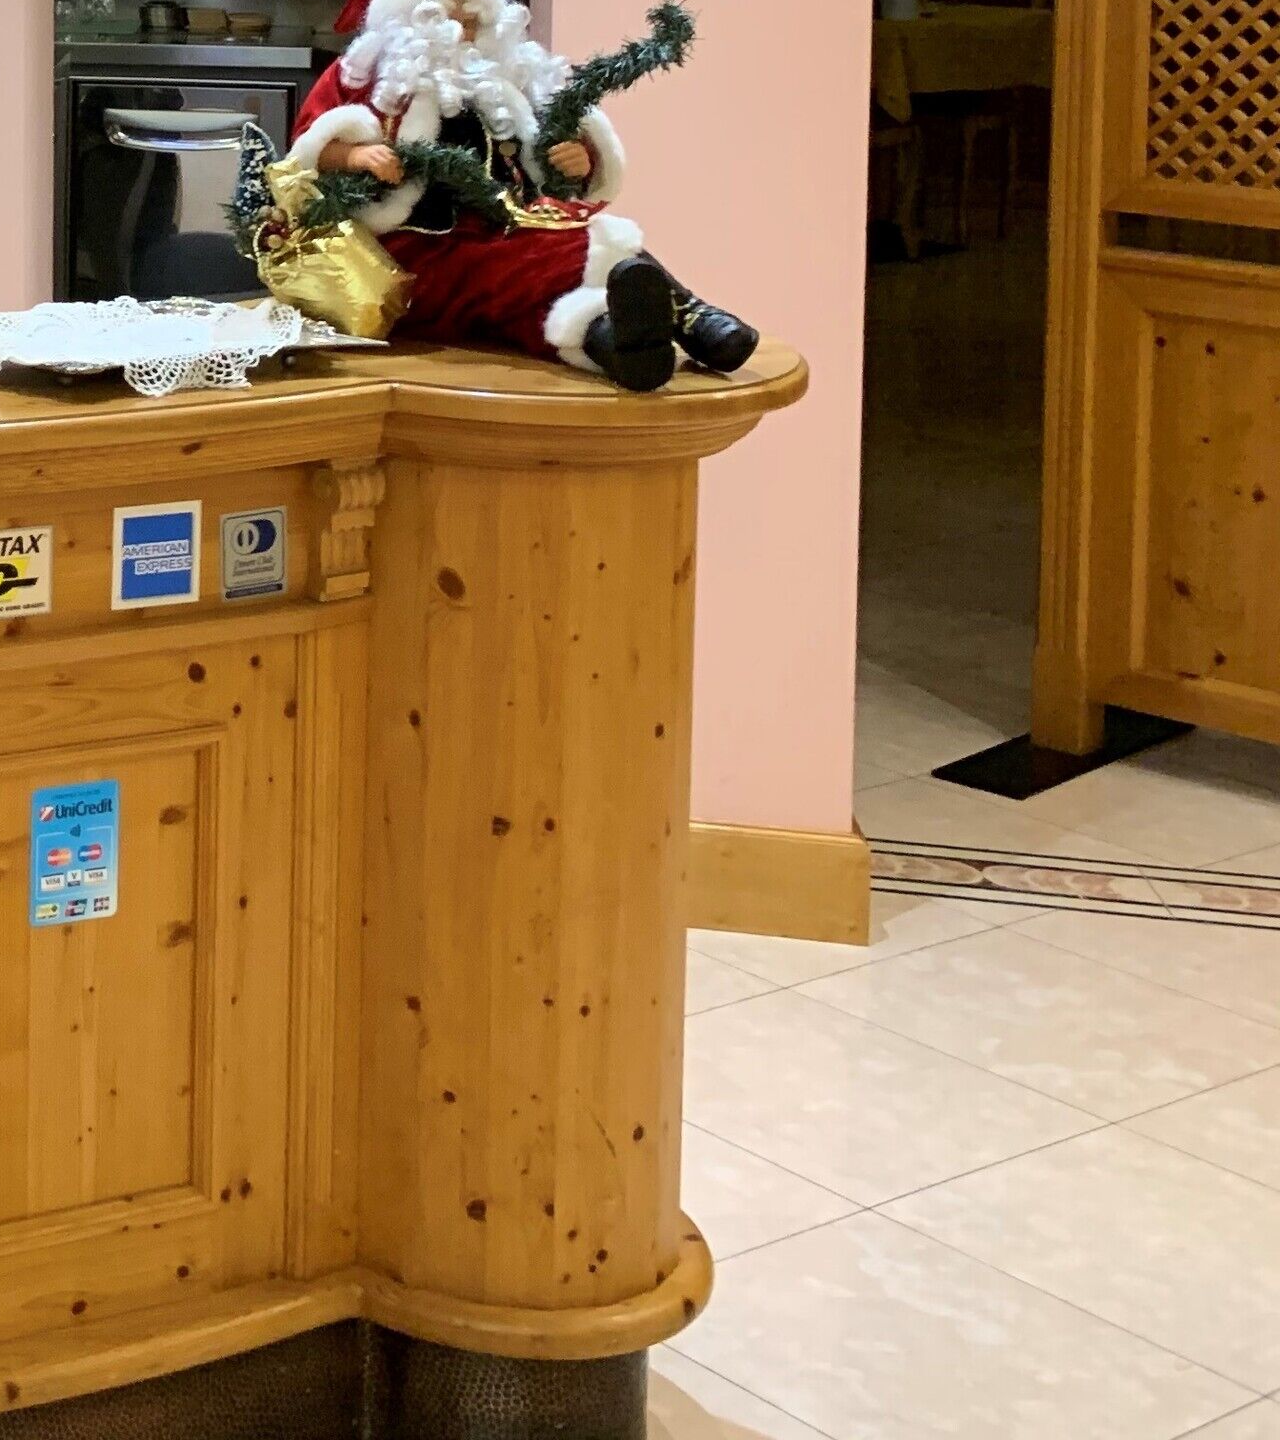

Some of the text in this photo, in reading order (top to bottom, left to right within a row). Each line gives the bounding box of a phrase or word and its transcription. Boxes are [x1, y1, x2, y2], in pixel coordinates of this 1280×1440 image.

[123, 541, 187, 557] AMERICAN
[136, 560, 191, 573] EXPRESS
[55, 799, 113, 820] UniCredit
